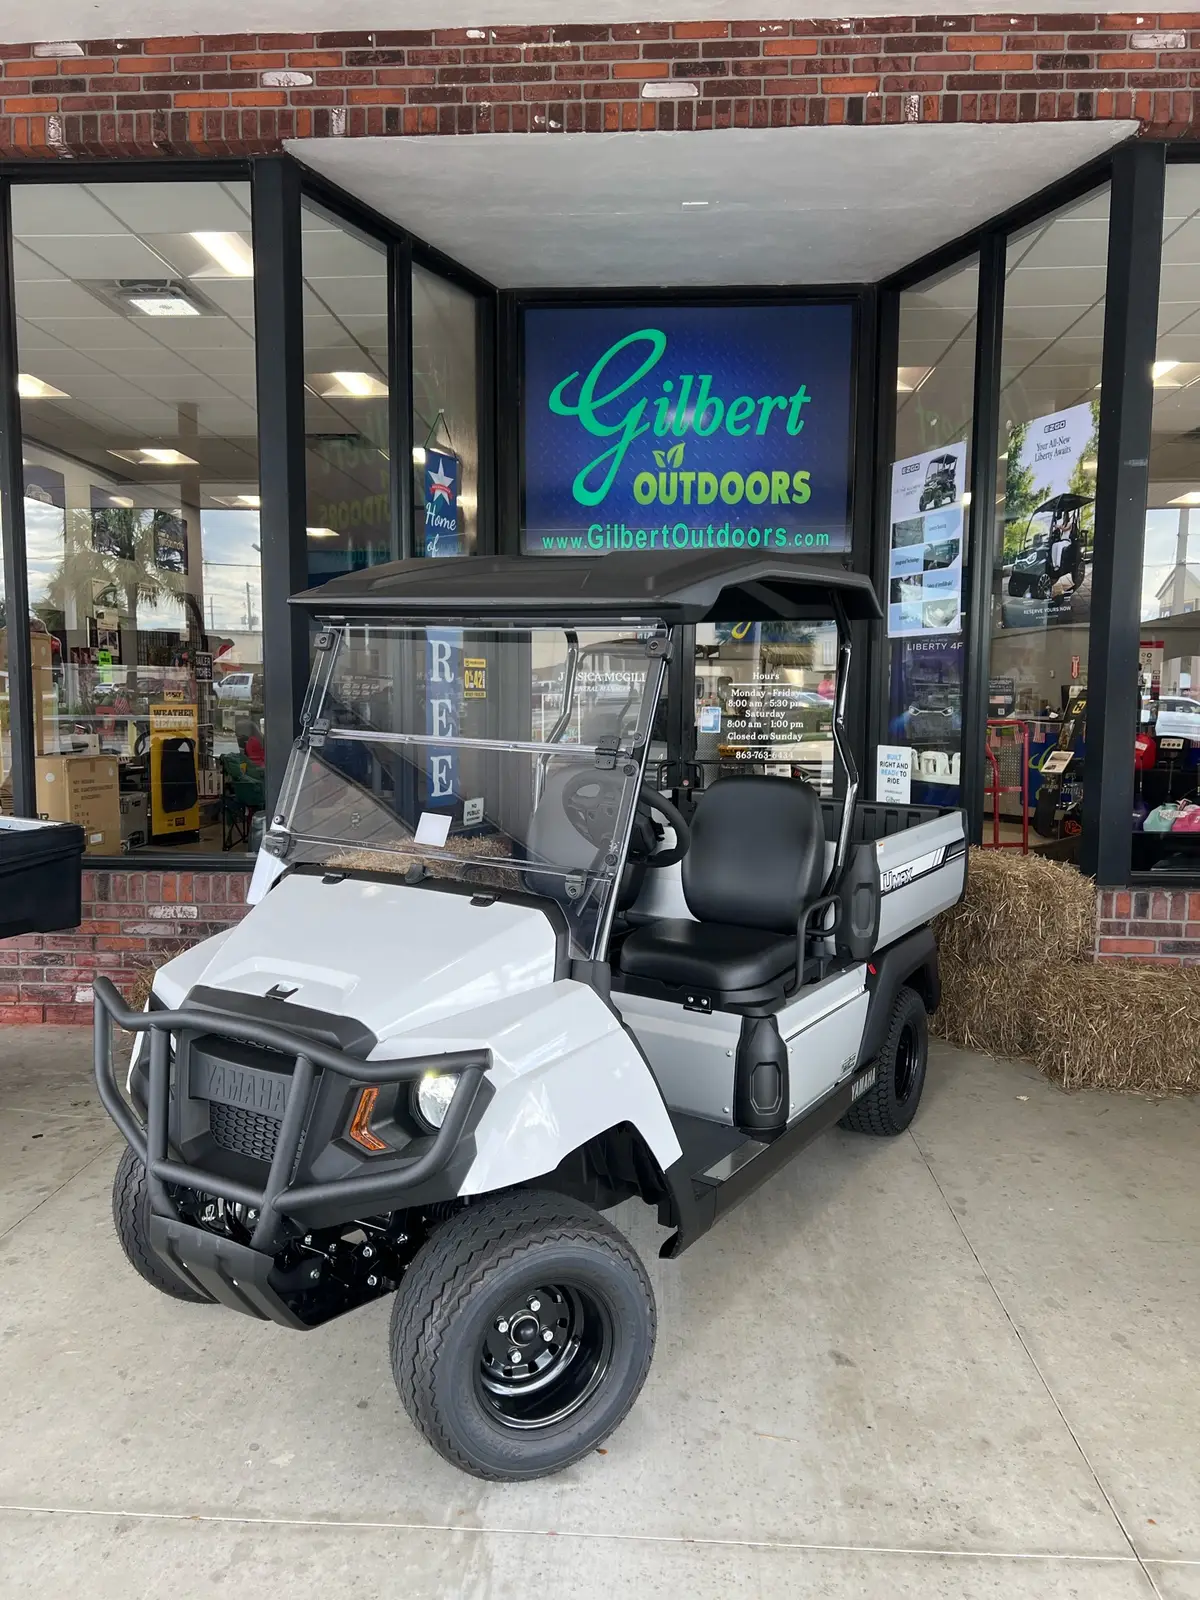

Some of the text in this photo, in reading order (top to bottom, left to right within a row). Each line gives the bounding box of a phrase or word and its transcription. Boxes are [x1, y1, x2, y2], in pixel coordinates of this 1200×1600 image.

[549, 328, 811, 506] Gilbert
[1036, 437, 1071, 451] Your All-New
[1035, 446, 1071, 462] Liberty Awaits
[633, 471, 811, 505] OUTDOORS
[425, 502, 456, 531] Home
[542, 523, 830, 551] www.GilbertOutdoors.com
[427, 533, 440, 557] of
[907, 641, 964, 651] LIBERTY 4F
[558, 672, 602, 682] JSICA
[753, 672, 780, 680] Hours
[731, 689, 766, 699] Monday
[773, 689, 800, 698] Friday
[790, 701, 803, 709] pm
[745, 710, 786, 719] Saturday
[727, 720, 746, 728] 8:00
[771, 720, 788, 728] 1:00
[727, 732, 756, 740] Closed
[770, 732, 803, 741] Sunday
[735, 751, 793, 759] 863-763-6434
[880, 760, 896, 768] RIGHT
[887, 777, 900, 785] RIDE
[206, 1062, 287, 1113] YAMAHA
[851, 1067, 876, 1101] YAMAHA
